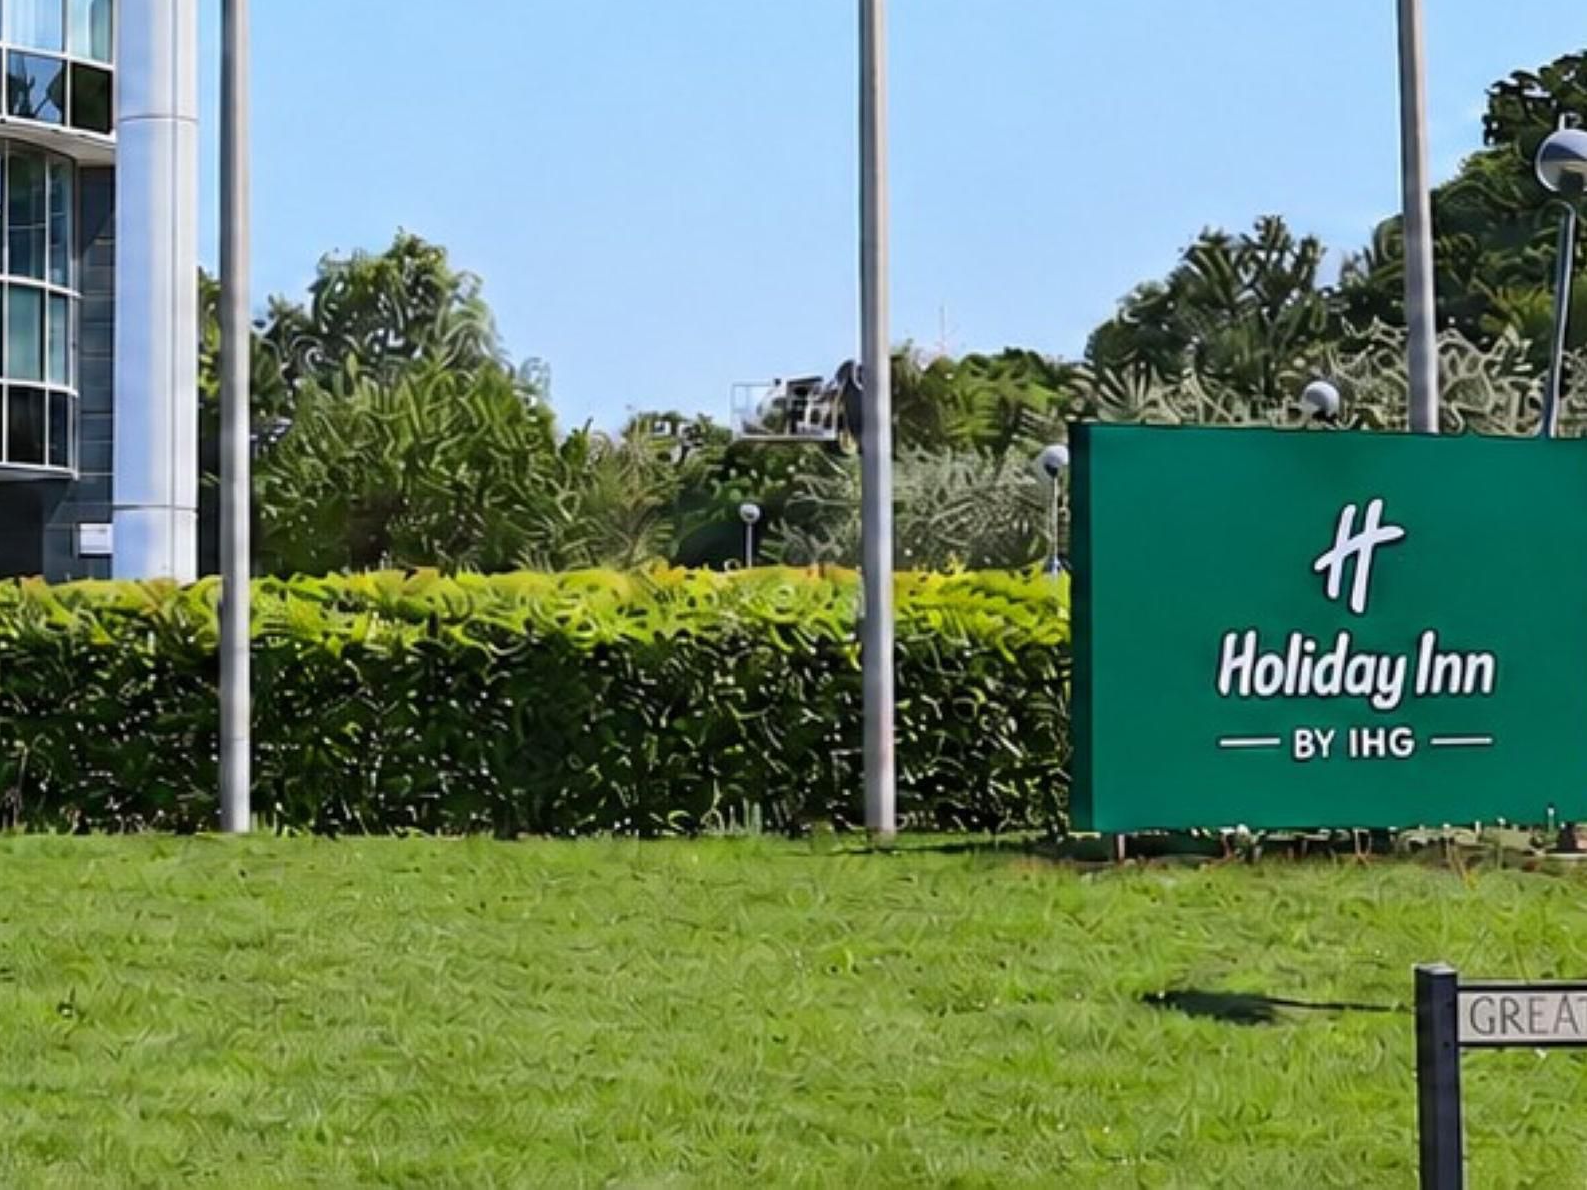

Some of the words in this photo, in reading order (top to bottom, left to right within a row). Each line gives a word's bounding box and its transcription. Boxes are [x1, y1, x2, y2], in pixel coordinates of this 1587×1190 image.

[1218, 630, 1407, 709] Holiday
[1415, 630, 1495, 695] Inn
[1294, 729, 1335, 759] BY
[1349, 728, 1415, 758] IHG
